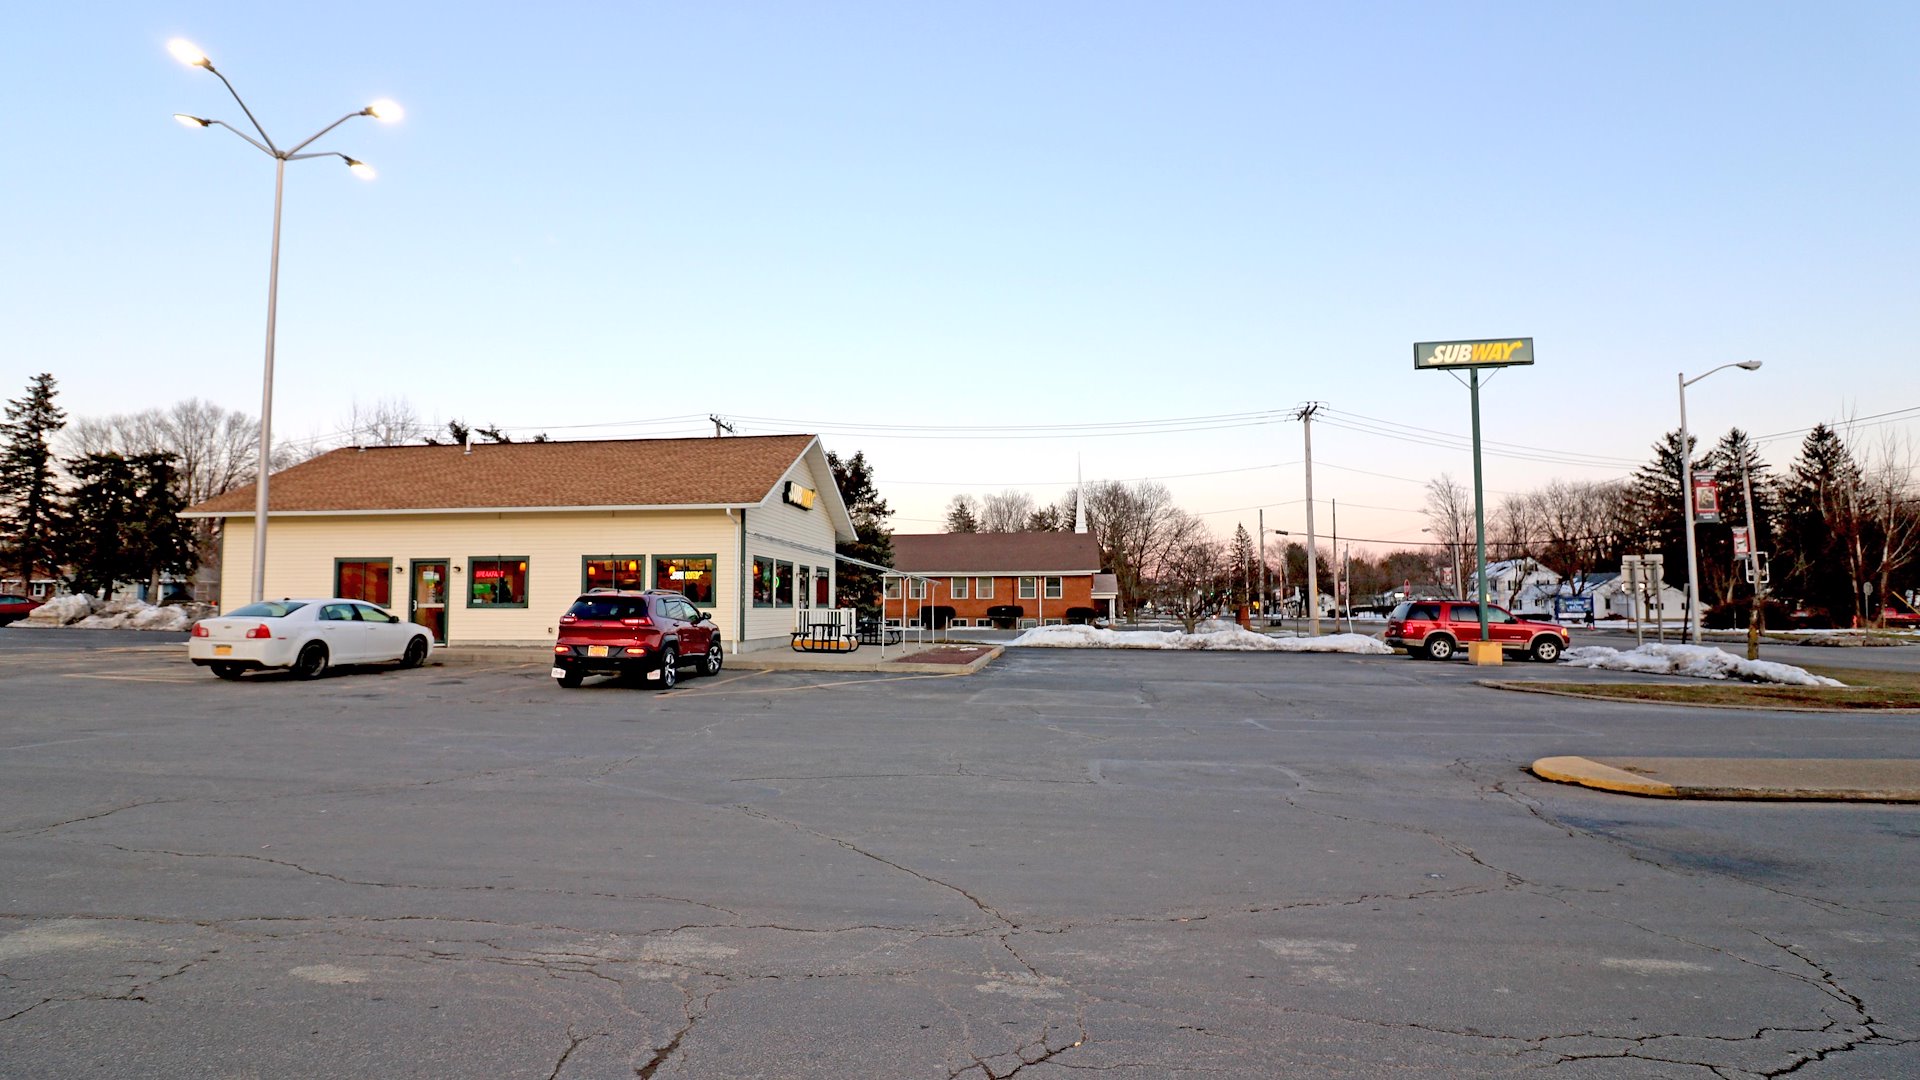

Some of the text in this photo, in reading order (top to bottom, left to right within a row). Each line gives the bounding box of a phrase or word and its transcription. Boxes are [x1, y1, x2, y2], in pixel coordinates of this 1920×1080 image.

[1428, 341, 1523, 364] SUBWAY
[788, 482, 816, 509] SUBWAY
[475, 570, 505, 578] BREAKFAT
